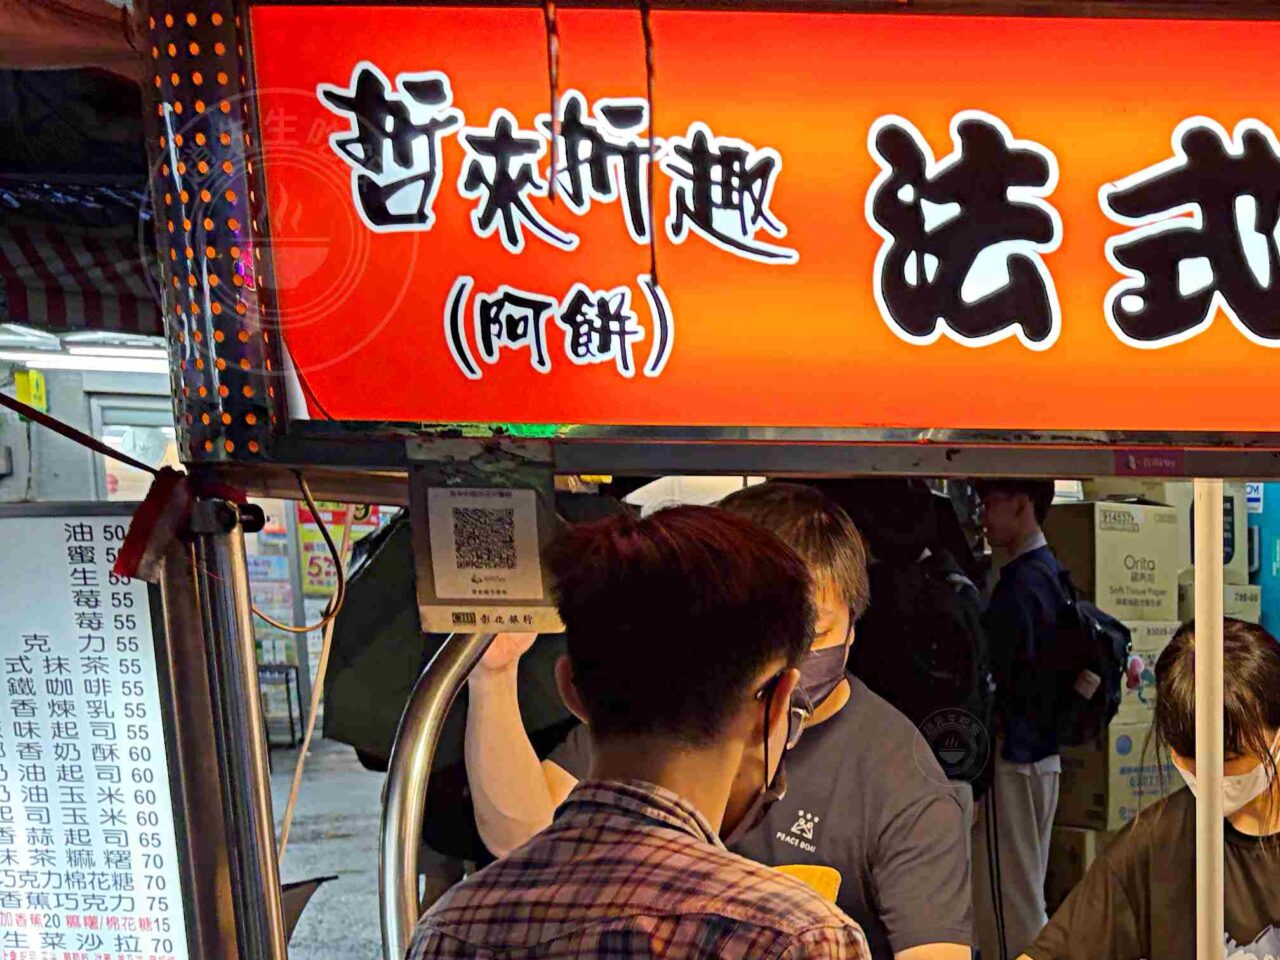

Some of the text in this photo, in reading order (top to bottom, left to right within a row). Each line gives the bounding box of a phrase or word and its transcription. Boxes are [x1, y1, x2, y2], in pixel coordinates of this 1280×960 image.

[317, 62, 798, 264] 哲來折趣
[445, 275, 674, 379] (阿餅)
[103, 525, 126, 541] 50
[1124, 555, 1155, 571] Orita
[70, 568, 99, 587] 生
[111, 592, 134, 607] 55
[114, 614, 136, 629] 55
[116, 636, 139, 651] 55
[119, 658, 141, 674] 55
[121, 681, 143, 696] 55
[124, 703, 146, 718] 55
[127, 725, 148, 740] 55
[129, 747, 151, 762] 60
[131, 768, 154, 783] 60
[134, 790, 156, 805] 60
[136, 811, 158, 826] 60
[139, 832, 161, 847] 65
[141, 854, 163, 869] 70
[144, 875, 165, 890] 70
[146, 897, 168, 911] 75
[3, 931, 173, 953] 生菜沙拉 70
